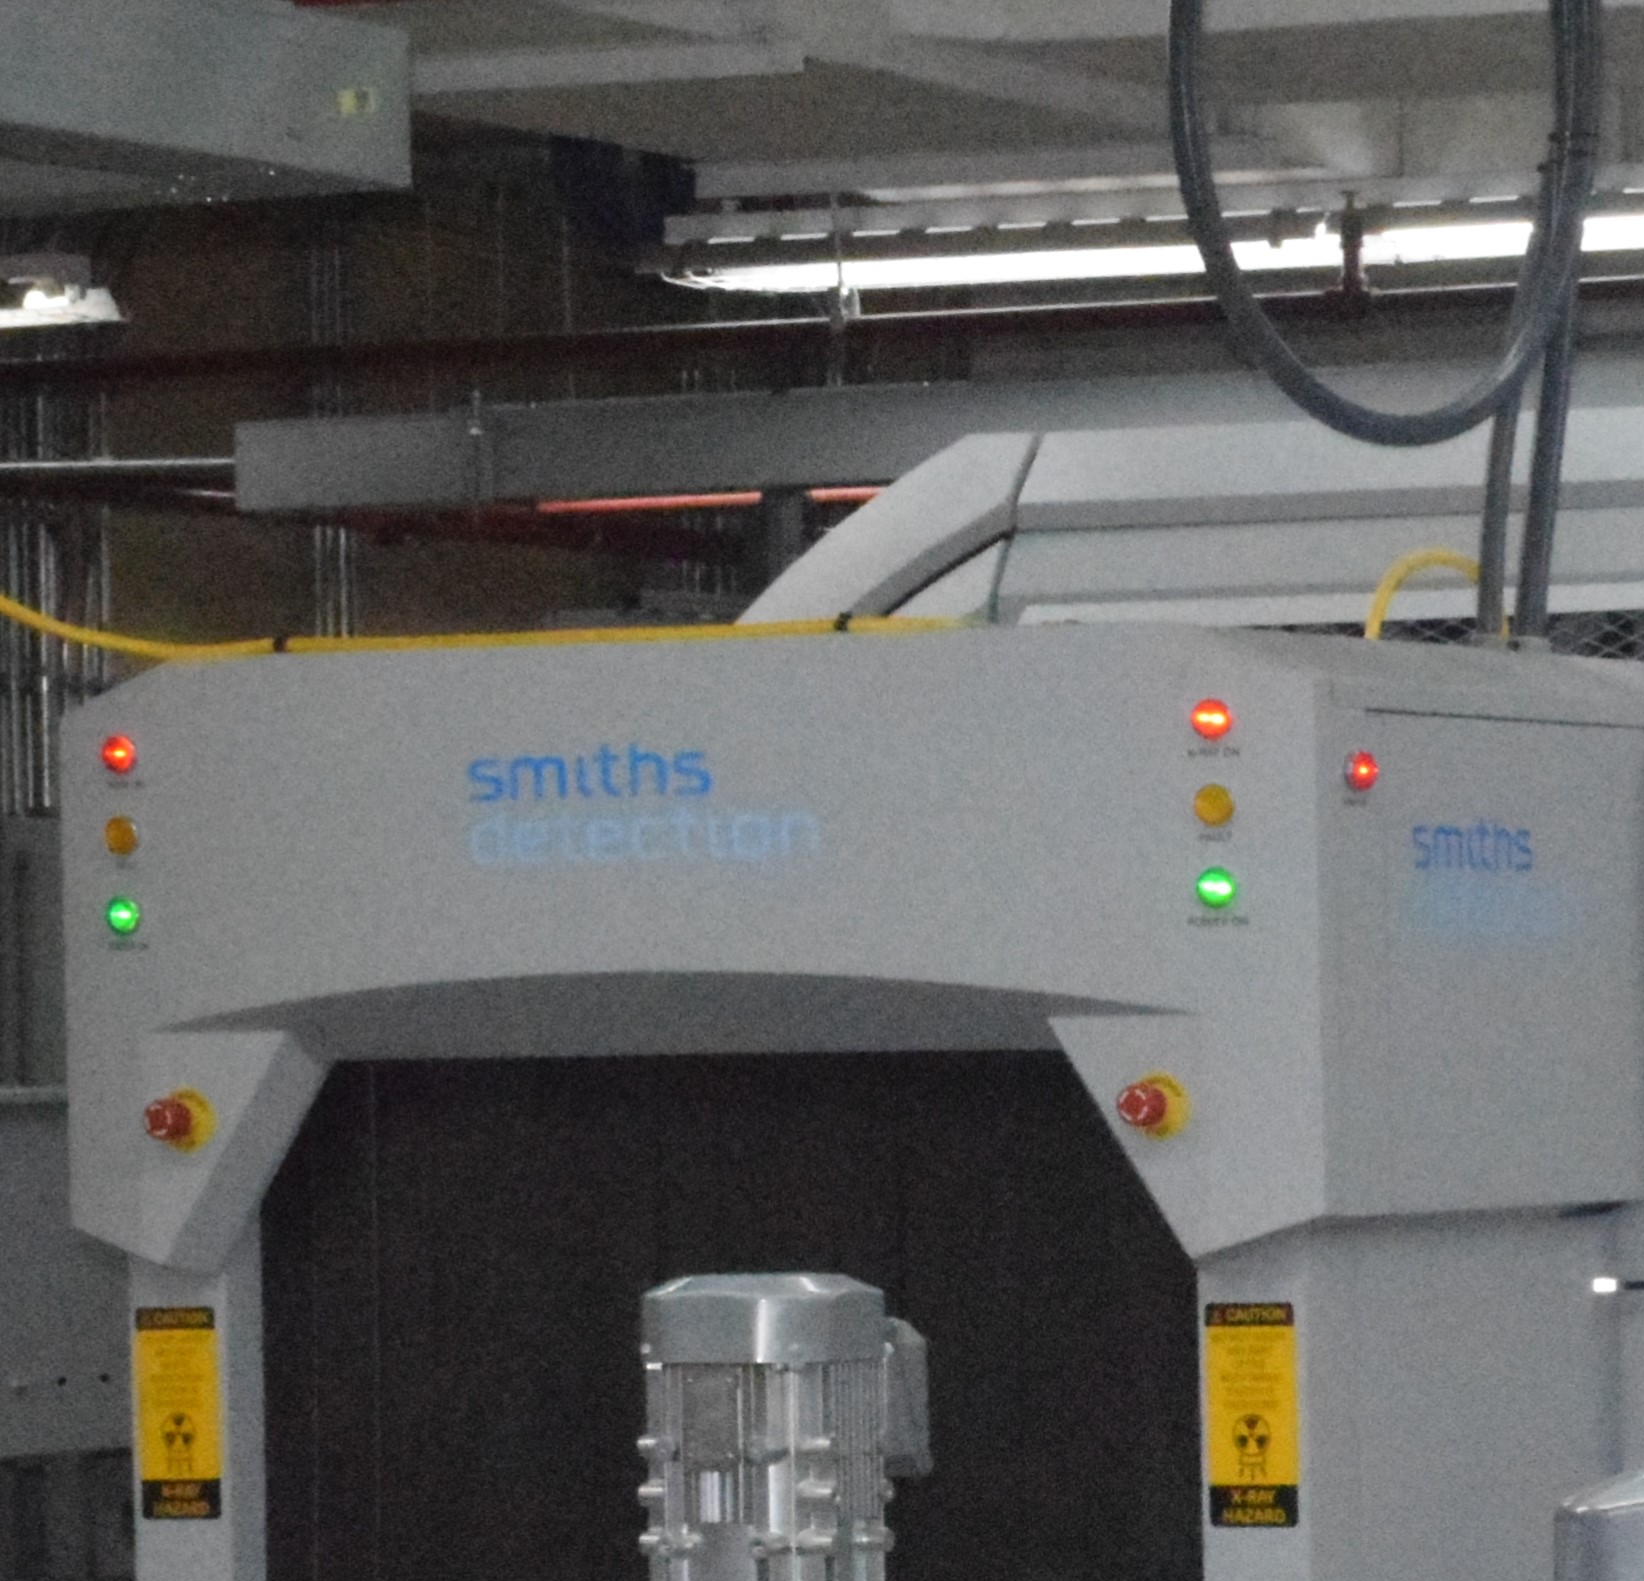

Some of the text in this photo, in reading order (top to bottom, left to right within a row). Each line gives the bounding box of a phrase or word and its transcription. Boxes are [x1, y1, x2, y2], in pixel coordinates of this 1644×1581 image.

[467, 740, 715, 802] smiths
[467, 807, 822, 868] detection
[1411, 818, 1533, 871] smiths
[1226, 1307, 1287, 1322] CAUTION
[1221, 1507, 1287, 1524] HAZARD
